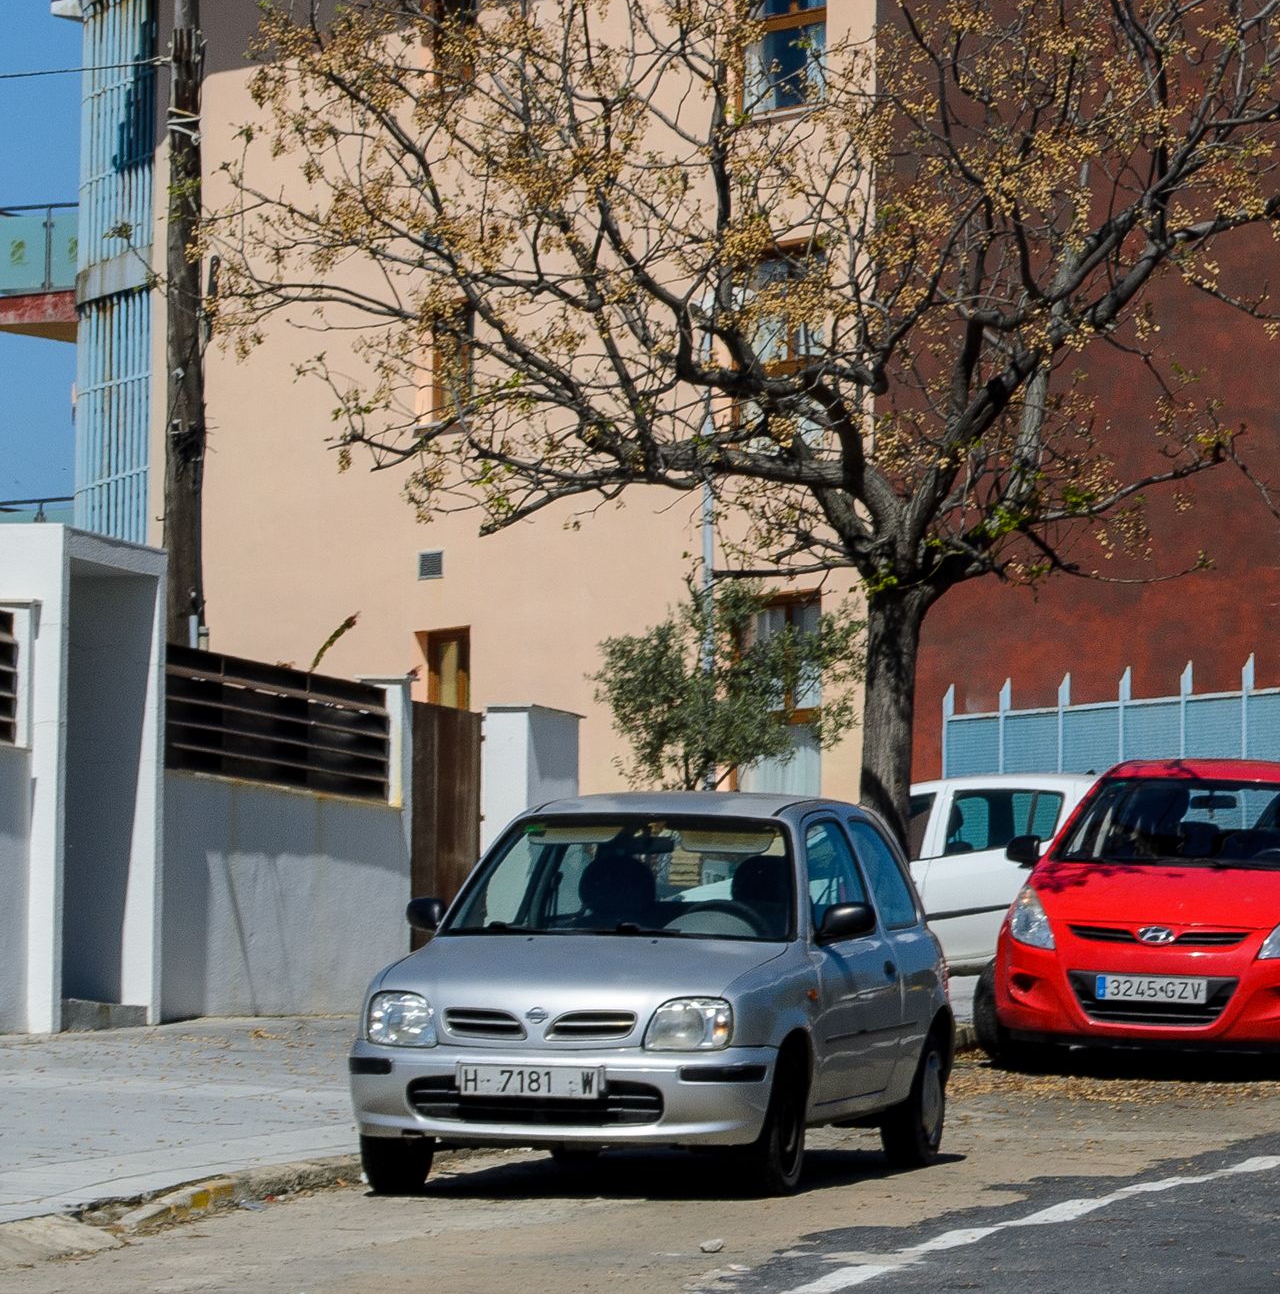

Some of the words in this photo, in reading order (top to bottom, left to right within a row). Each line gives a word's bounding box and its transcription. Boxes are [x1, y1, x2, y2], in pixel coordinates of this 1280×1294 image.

[1110, 979, 1161, 999] 3245
[1164, 981, 1203, 1000] GZV
[463, 1069, 478, 1092] H
[499, 1070, 553, 1093] 7181
[581, 1072, 595, 1094] W
